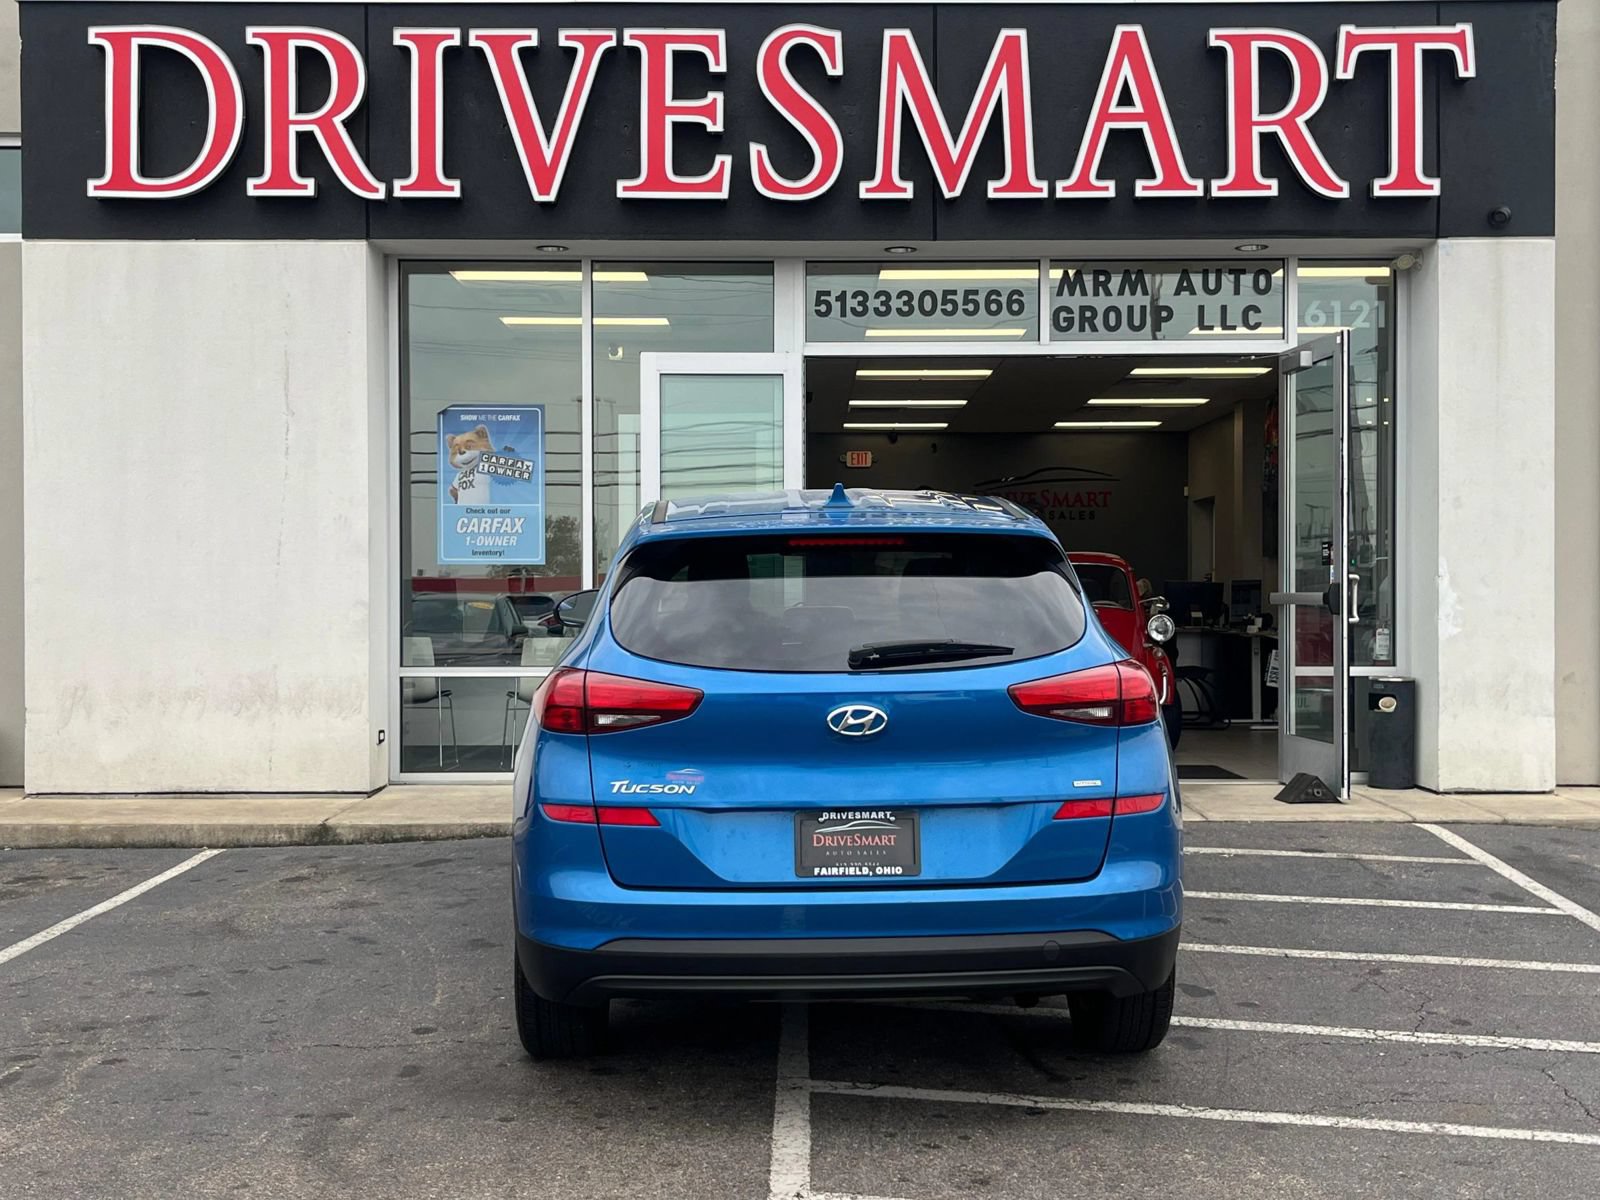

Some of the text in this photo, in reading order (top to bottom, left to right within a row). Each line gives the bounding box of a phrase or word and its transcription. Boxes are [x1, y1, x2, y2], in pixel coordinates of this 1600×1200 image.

[86, 23, 1476, 202] DRIVESMART
[1056, 268, 1273, 297] MRM AUTO
[814, 289, 1025, 318] 5133305566
[1052, 304, 1263, 332] GROUP LLC
[1303, 299, 1386, 329] 6121
[497, 414, 521, 422] CARFAX
[482, 453, 533, 472] CARFAX
[850, 452, 869, 466] EXIT
[1048, 510, 1096, 521] SALES
[456, 517, 525, 534] CARFAX
[465, 535, 518, 547] 1-OWNER
[471, 549, 505, 557] Inventory!
[822, 811, 892, 820] DRIVESMART
[813, 866, 903, 877] FAIRFIELD, OHIO
